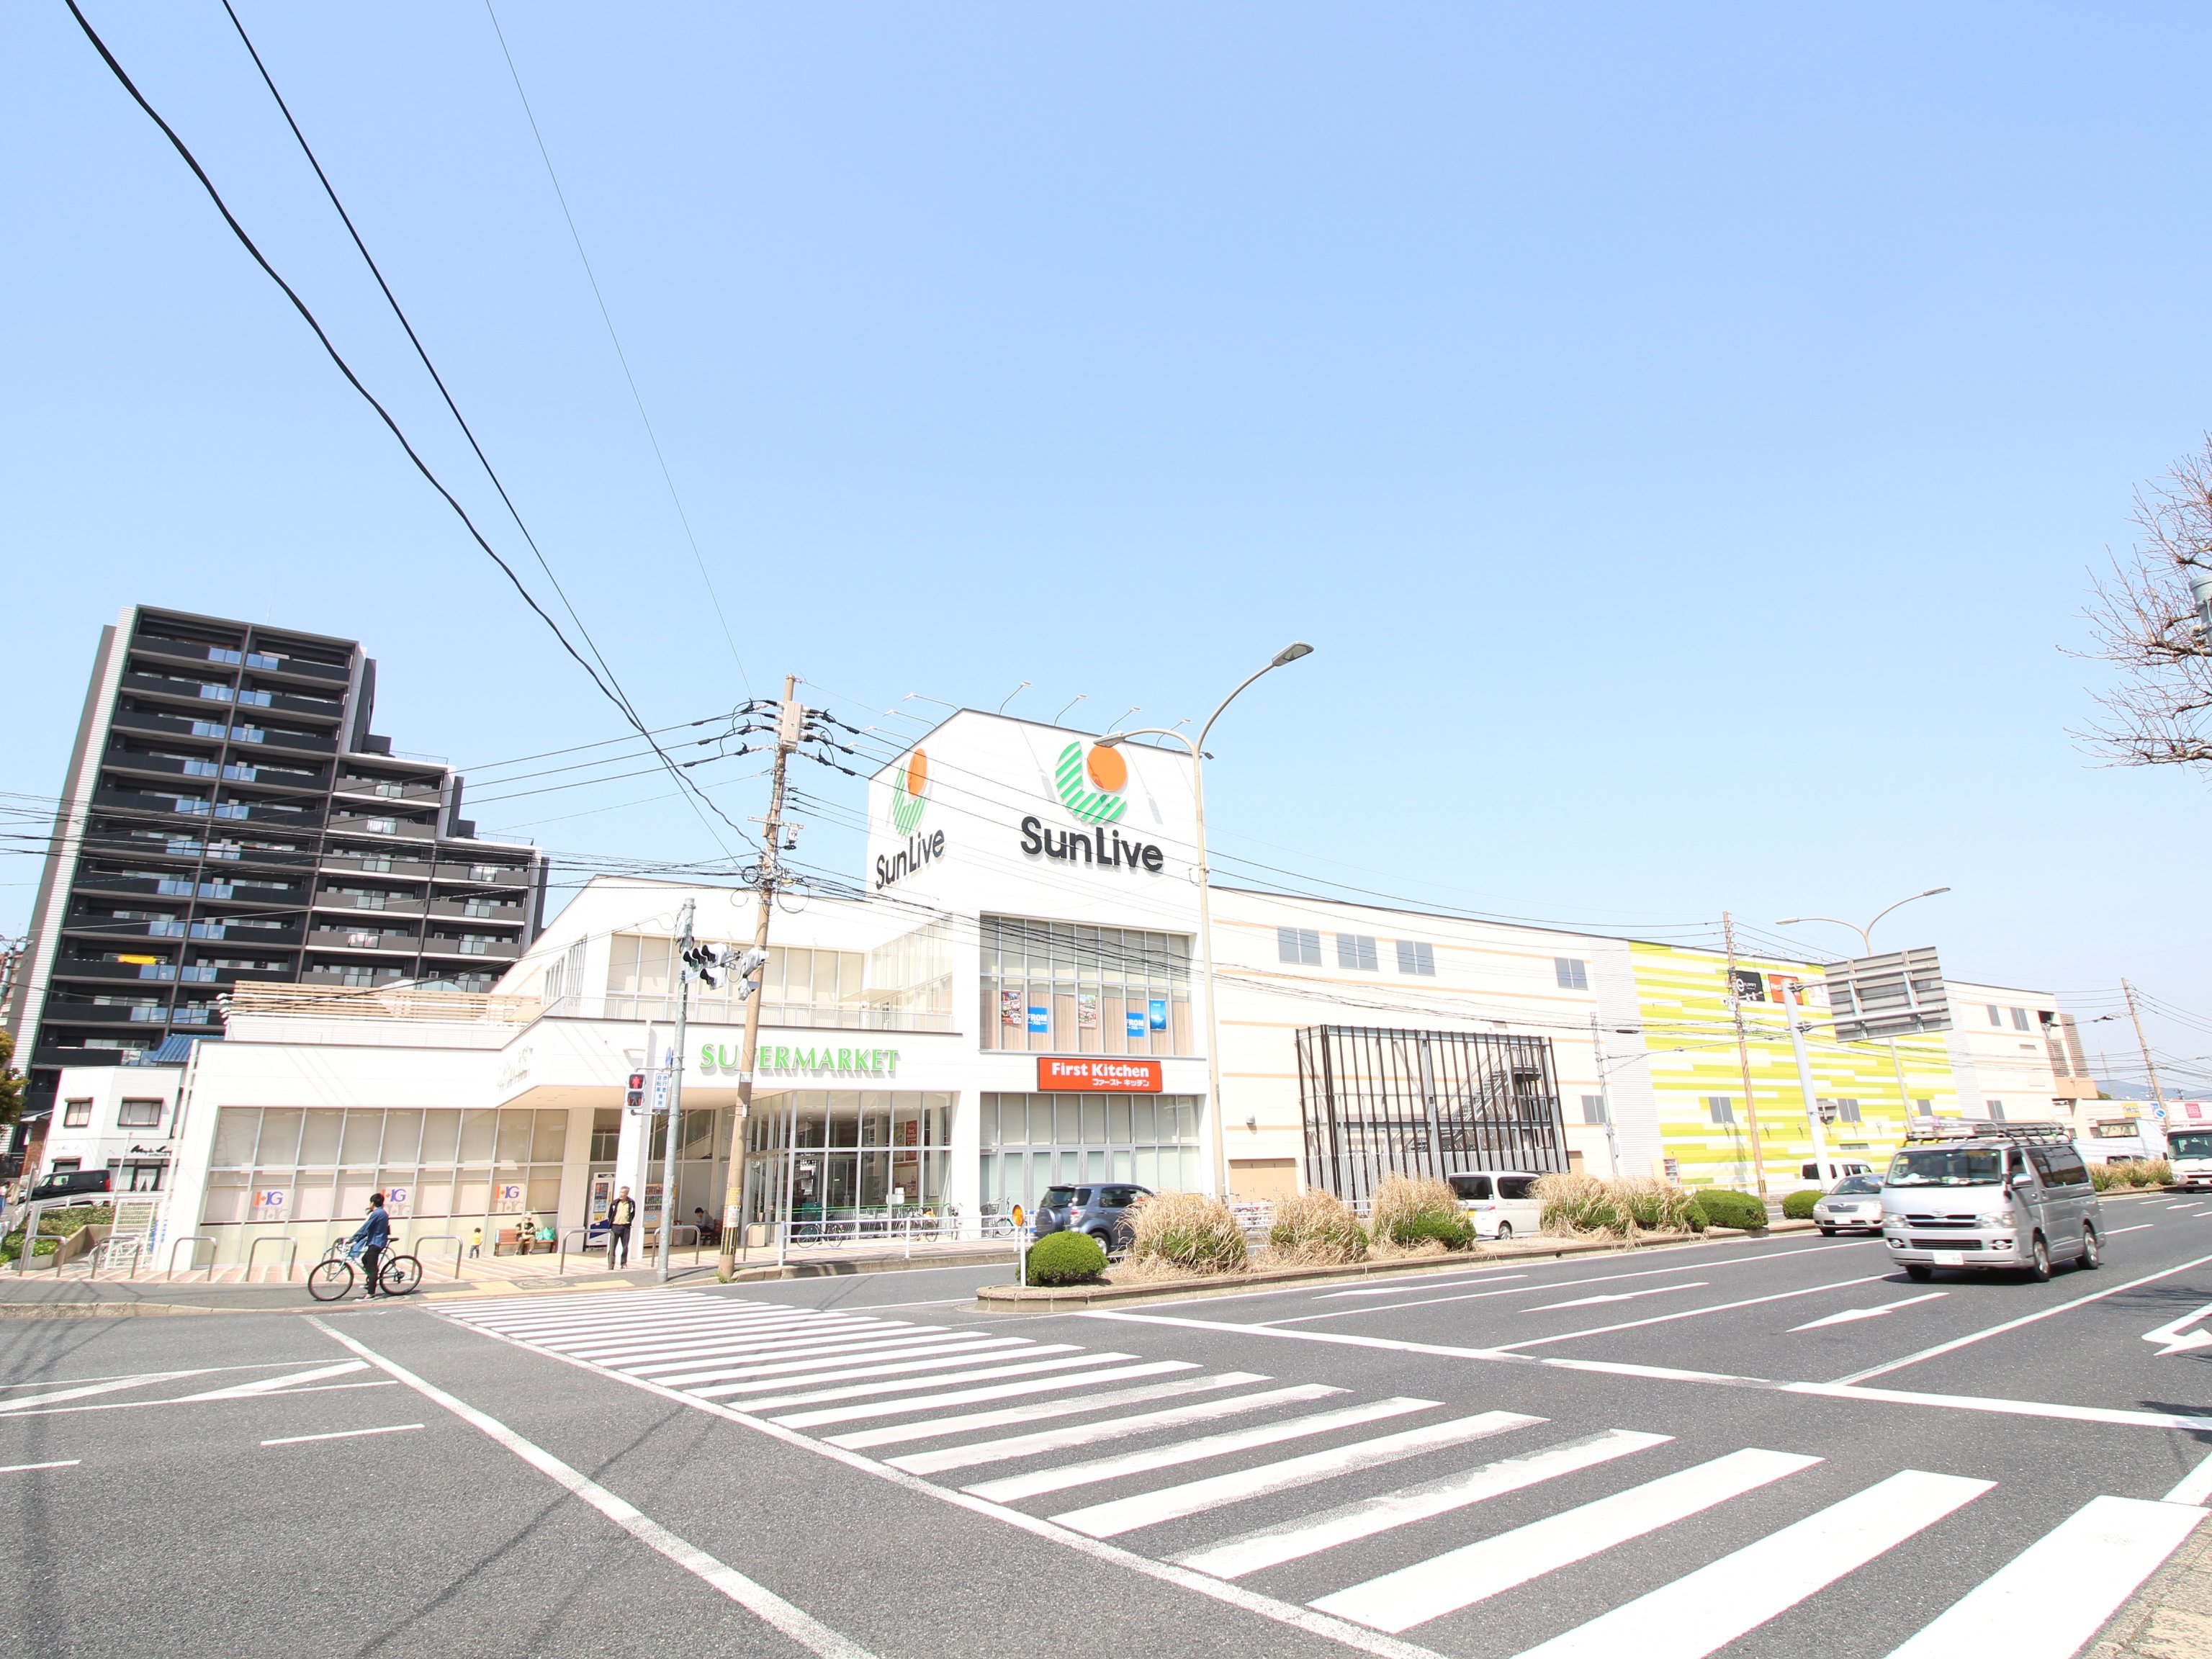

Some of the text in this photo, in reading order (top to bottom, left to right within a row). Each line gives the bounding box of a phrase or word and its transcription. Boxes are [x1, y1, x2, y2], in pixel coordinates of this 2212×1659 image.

[876, 828, 945, 890] SunLive
[1020, 816, 1164, 872] SunLive
[699, 1043, 899, 1071] SUERMARKET
[1052, 1062, 1149, 1078] First Kitchen
